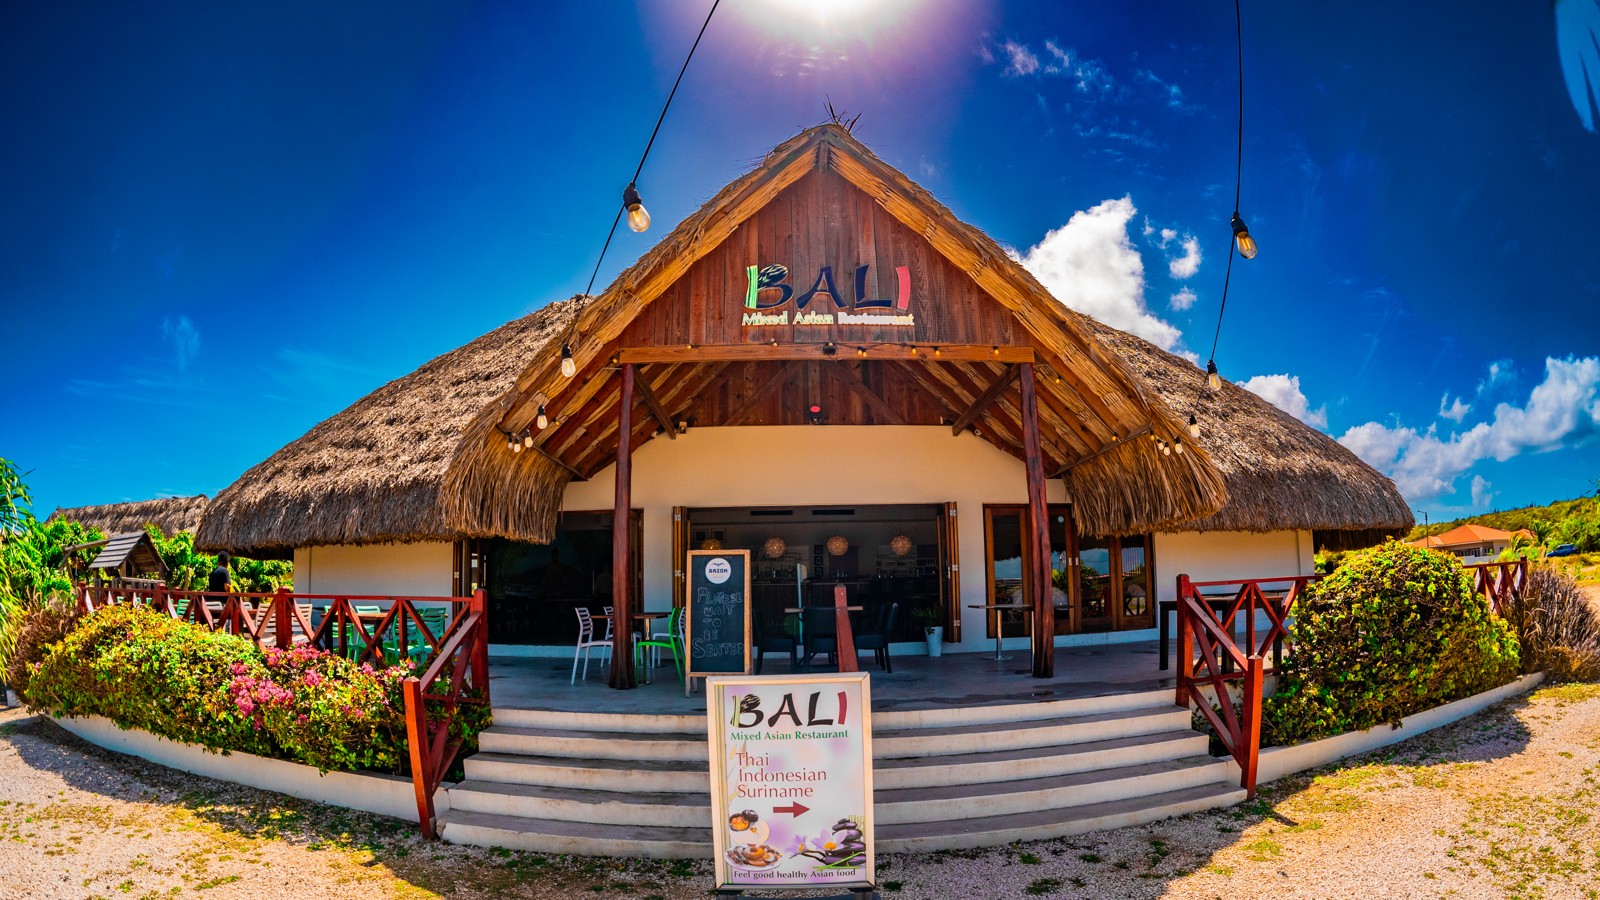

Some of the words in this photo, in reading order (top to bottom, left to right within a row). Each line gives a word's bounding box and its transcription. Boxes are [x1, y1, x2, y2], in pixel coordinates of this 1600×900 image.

[743, 264, 911, 310] BALI
[742, 310, 788, 326] Mixed
[792, 310, 834, 325] Asian
[704, 605, 733, 617] WAIT
[702, 618, 722, 628] TO
[703, 630, 719, 641] BE
[730, 691, 847, 728] BALI
[731, 731, 761, 741] Mixed
[764, 731, 792, 740] Asian
[795, 730, 848, 739] Restaurant
[736, 752, 769, 766] Thai
[739, 768, 827, 782] Indonesian
[737, 784, 813, 798] Suriname
[753, 871, 774, 880] good
[776, 870, 807, 879] healthy
[810, 870, 834, 878] Asian
[837, 868, 856, 877] food
